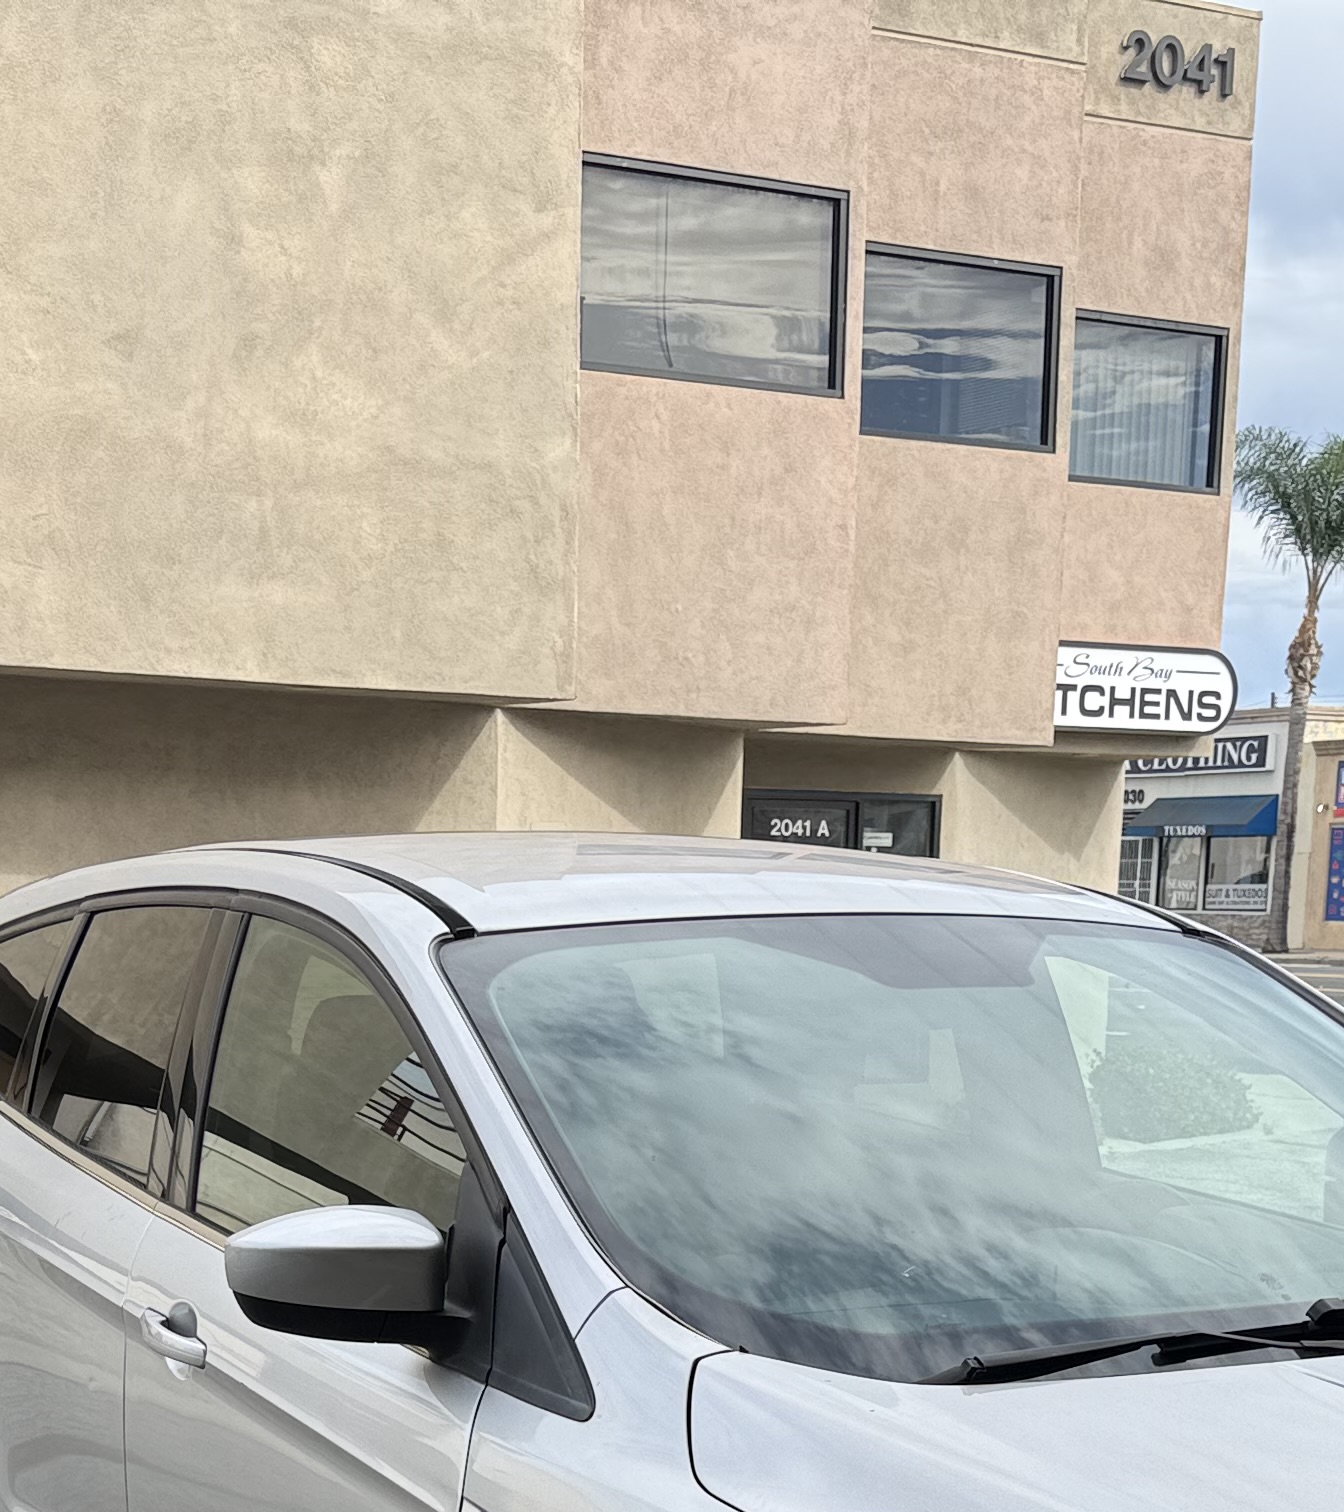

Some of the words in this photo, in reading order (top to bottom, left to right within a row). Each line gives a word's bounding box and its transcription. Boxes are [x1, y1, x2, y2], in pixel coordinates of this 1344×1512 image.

[1121, 29, 1236, 98] 2041
[1064, 653, 1124, 678] South
[1126, 656, 1173, 682] Bay
[1056, 684, 1222, 723] TCHENS
[770, 818, 811, 837] 2041
[817, 820, 830, 837] A
[1164, 825, 1206, 836] TUXEDOS
[1232, 888, 1268, 899] TUXEDOS
